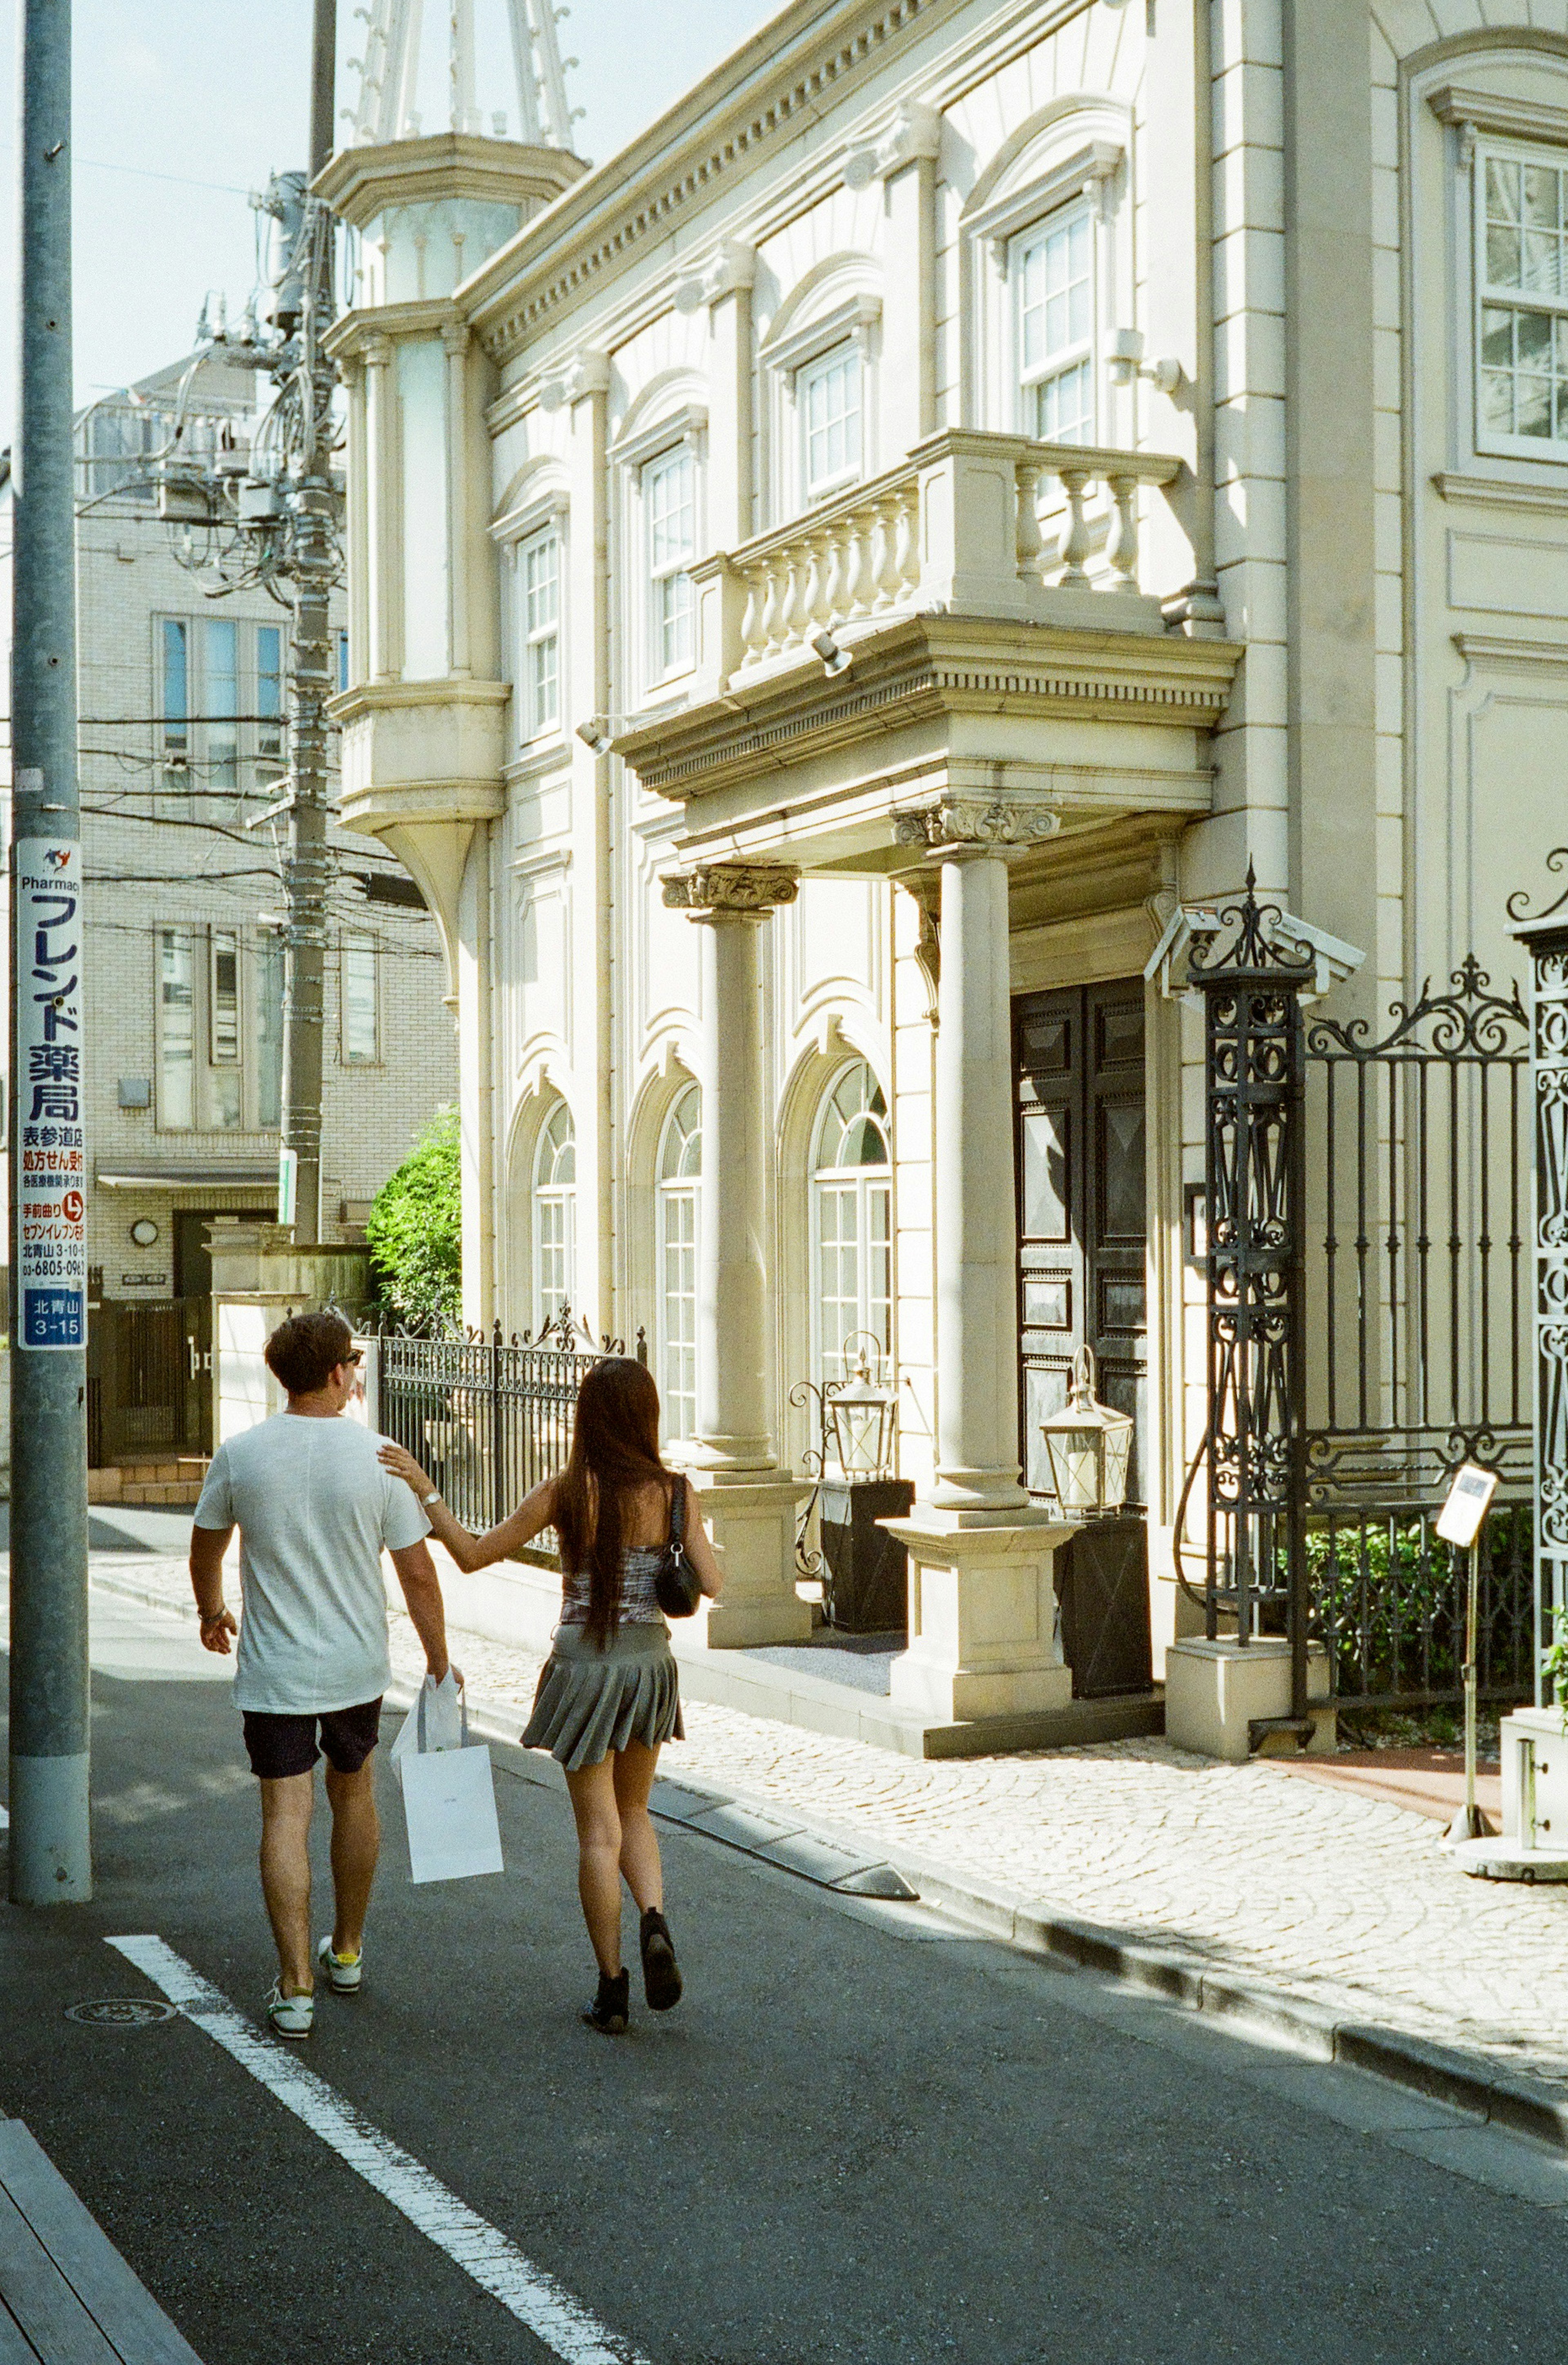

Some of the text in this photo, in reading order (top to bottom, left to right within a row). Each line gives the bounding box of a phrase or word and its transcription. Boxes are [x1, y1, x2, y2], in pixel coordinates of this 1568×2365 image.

[29, 895, 79, 1121] フレンド薬局
[23, 1126, 82, 1147] 表参道店
[23, 1150, 82, 1171] 処方せん受付
[23, 1203, 61, 1218] 手前曲り
[34, 1299, 78, 1314] 北青山
[35, 1320, 78, 1335] 3-15
